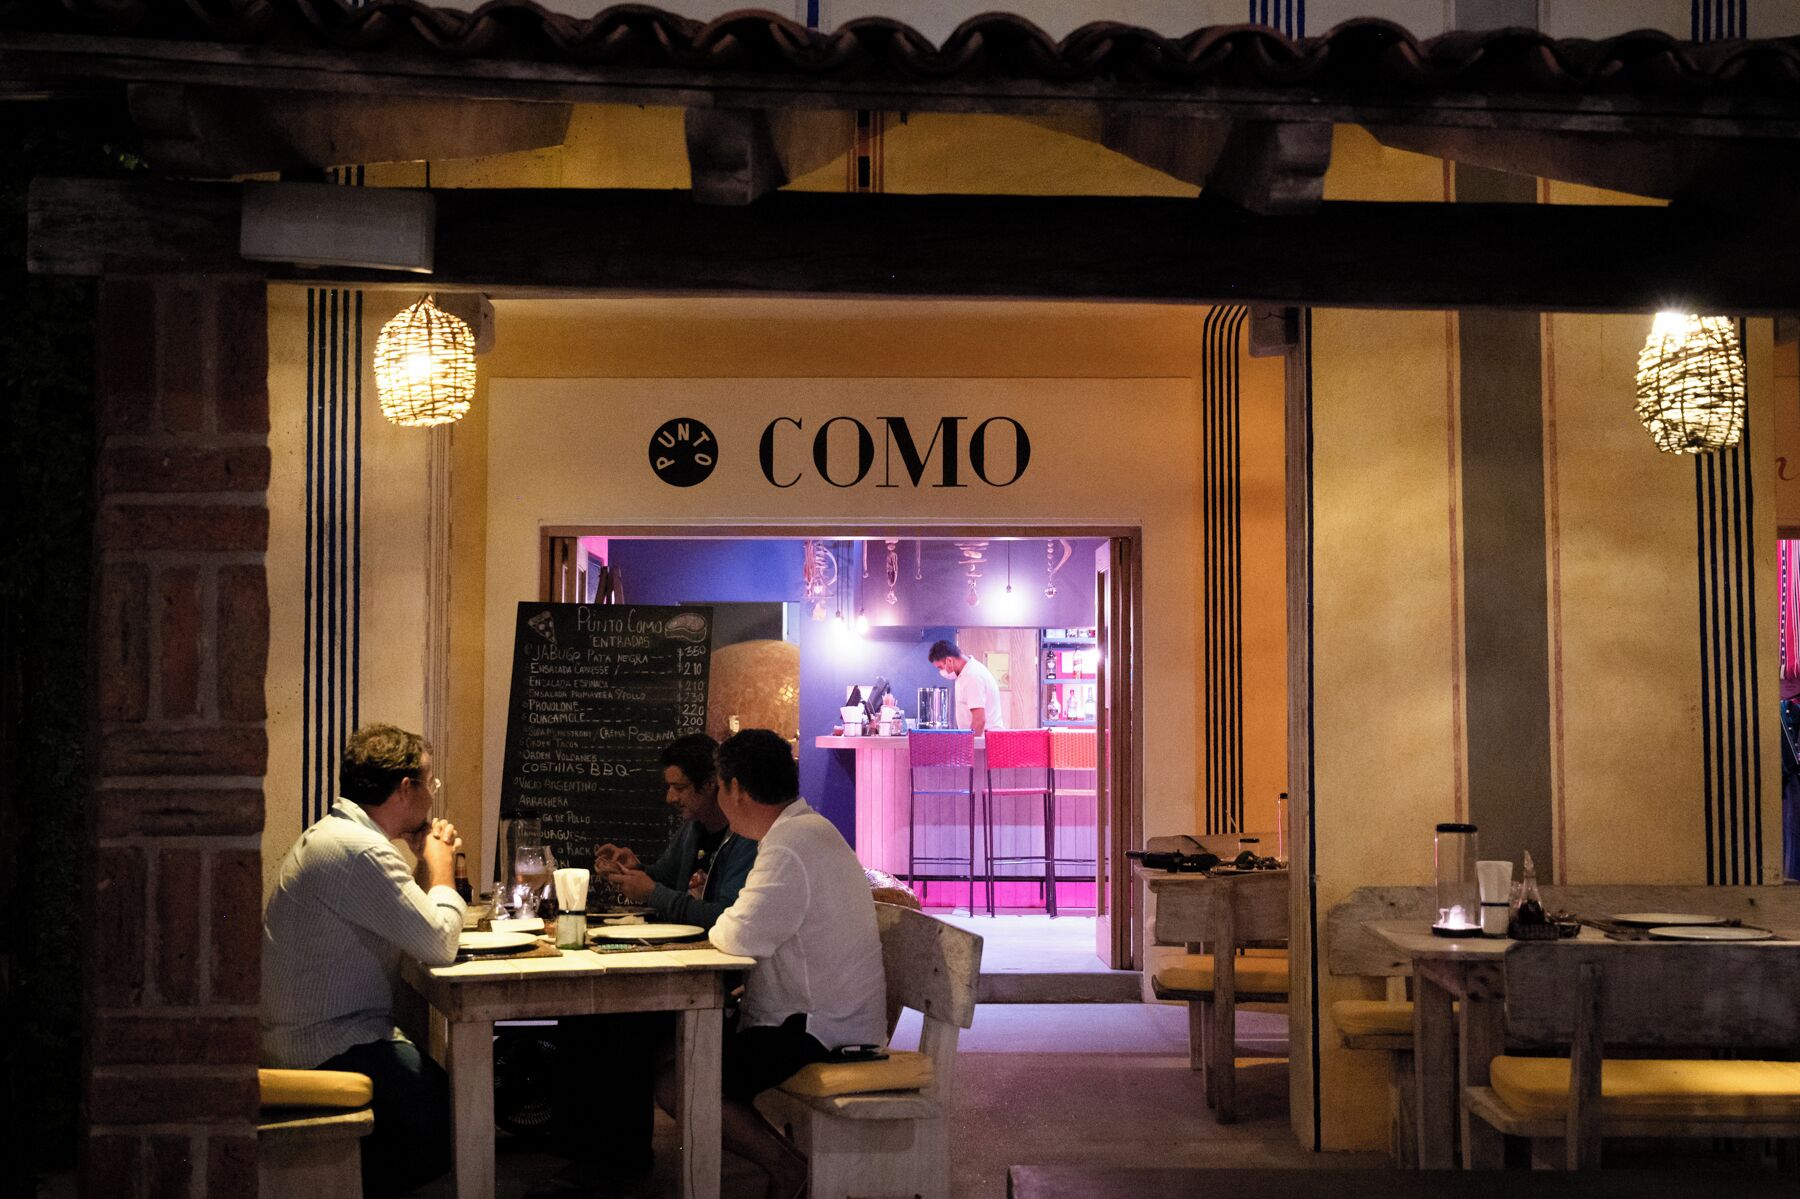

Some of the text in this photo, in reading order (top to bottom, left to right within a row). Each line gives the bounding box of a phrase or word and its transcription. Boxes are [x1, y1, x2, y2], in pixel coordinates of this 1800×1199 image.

[656, 416, 1031, 488] PUNTO COMO
[627, 608, 663, 633] COMO
